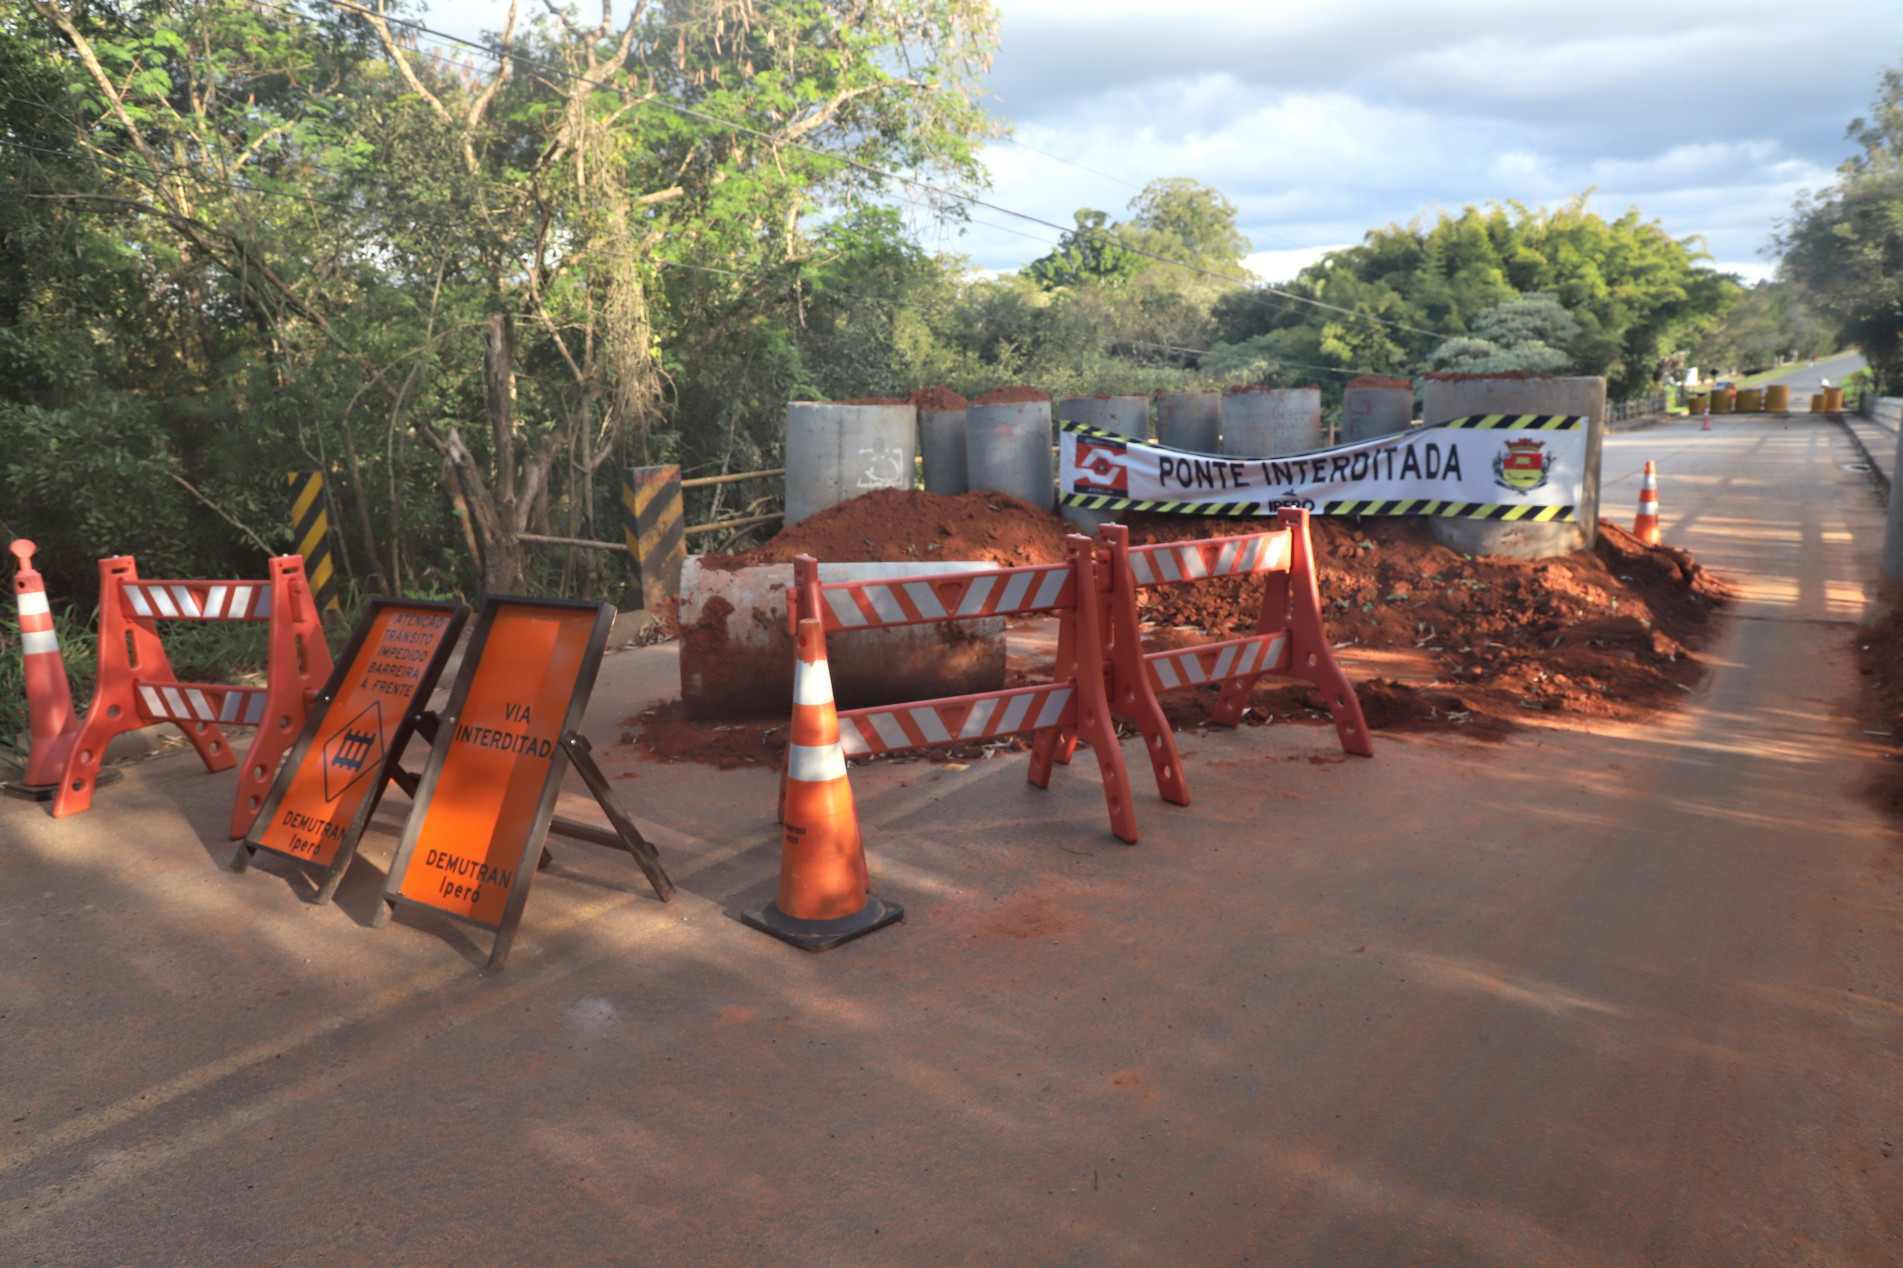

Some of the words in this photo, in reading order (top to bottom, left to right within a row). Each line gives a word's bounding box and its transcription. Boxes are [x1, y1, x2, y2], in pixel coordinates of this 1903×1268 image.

[1159, 455, 1250, 489] PONTE
[1261, 443, 1463, 486] INTERDITADA
[504, 702, 532, 725] VIA
[455, 725, 554, 759] INTERDITAD
[426, 848, 513, 889] DEMUTRAN
